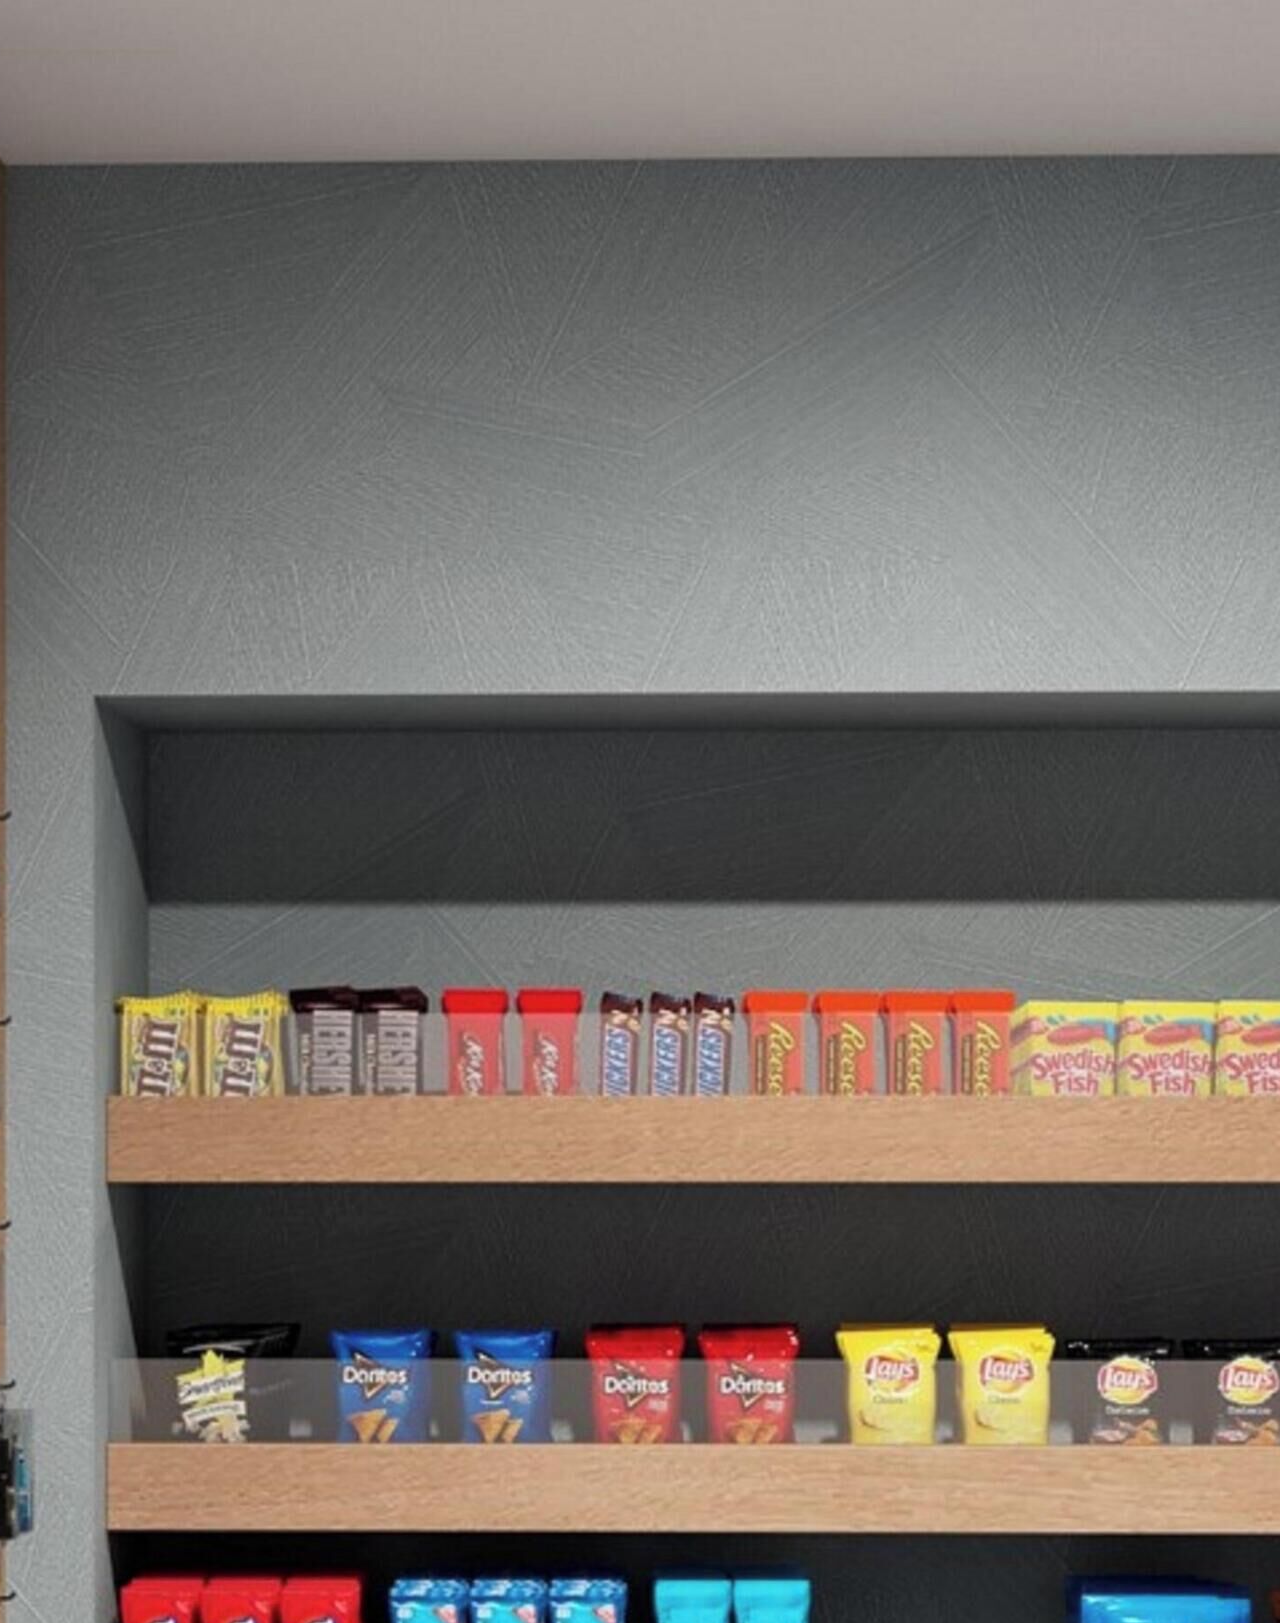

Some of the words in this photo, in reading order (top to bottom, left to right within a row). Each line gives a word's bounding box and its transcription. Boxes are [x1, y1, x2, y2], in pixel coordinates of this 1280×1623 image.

[1030, 1050, 1117, 1079] Swedish
[1127, 1050, 1216, 1079] Swedish
[1051, 1071, 1100, 1094] Fish
[1149, 1071, 1197, 1094] Fish
[342, 1366, 408, 1384] Doritos
[468, 1366, 533, 1384] Doritos
[603, 1375, 669, 1394] Doritos
[720, 1374, 786, 1394] Doritos
